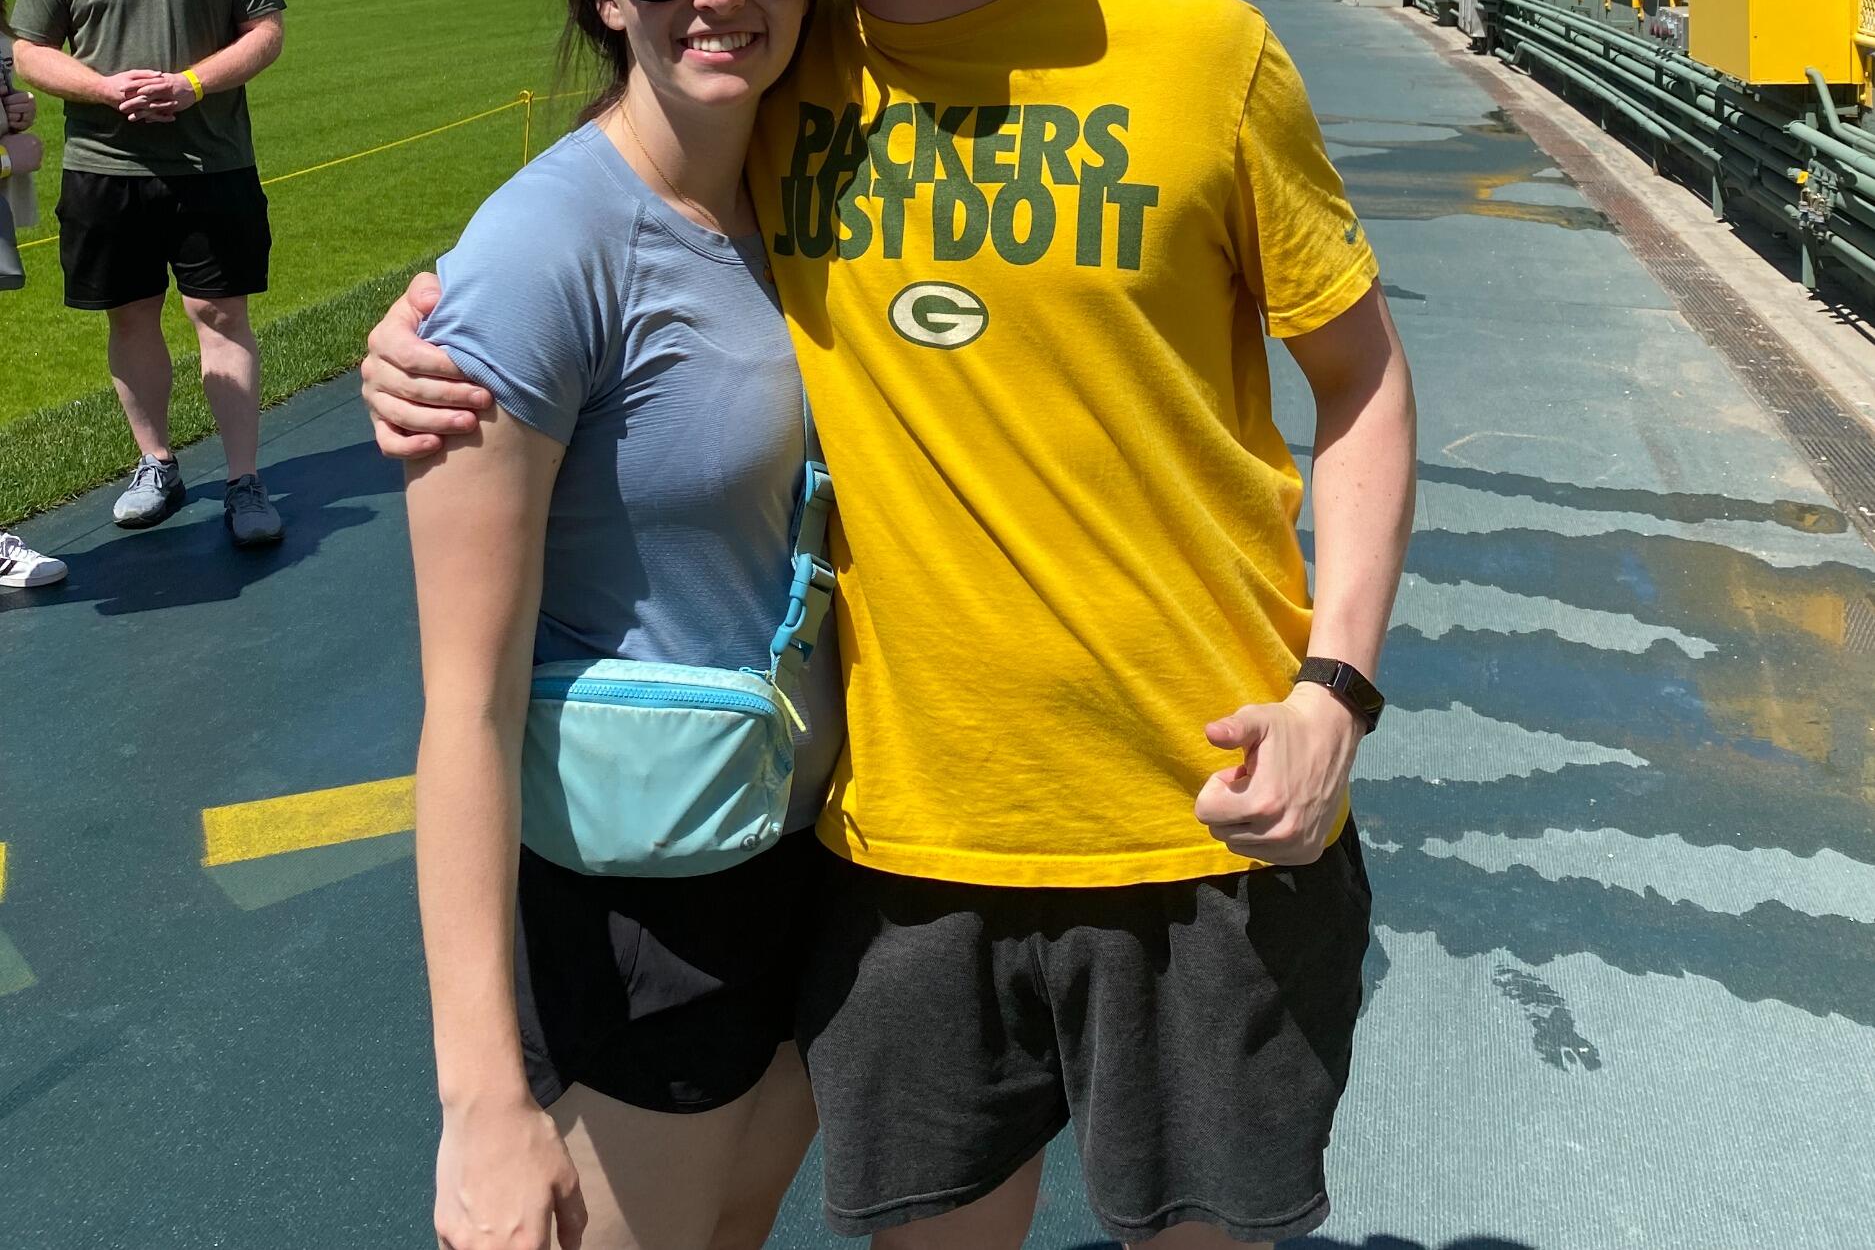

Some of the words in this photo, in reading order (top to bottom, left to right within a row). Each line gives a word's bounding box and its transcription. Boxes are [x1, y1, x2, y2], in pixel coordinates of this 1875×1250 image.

[790, 102, 1131, 184] PACKERS
[774, 176, 916, 260] JUST
[932, 179, 1057, 266] DO
[1076, 161, 1160, 270] IT
